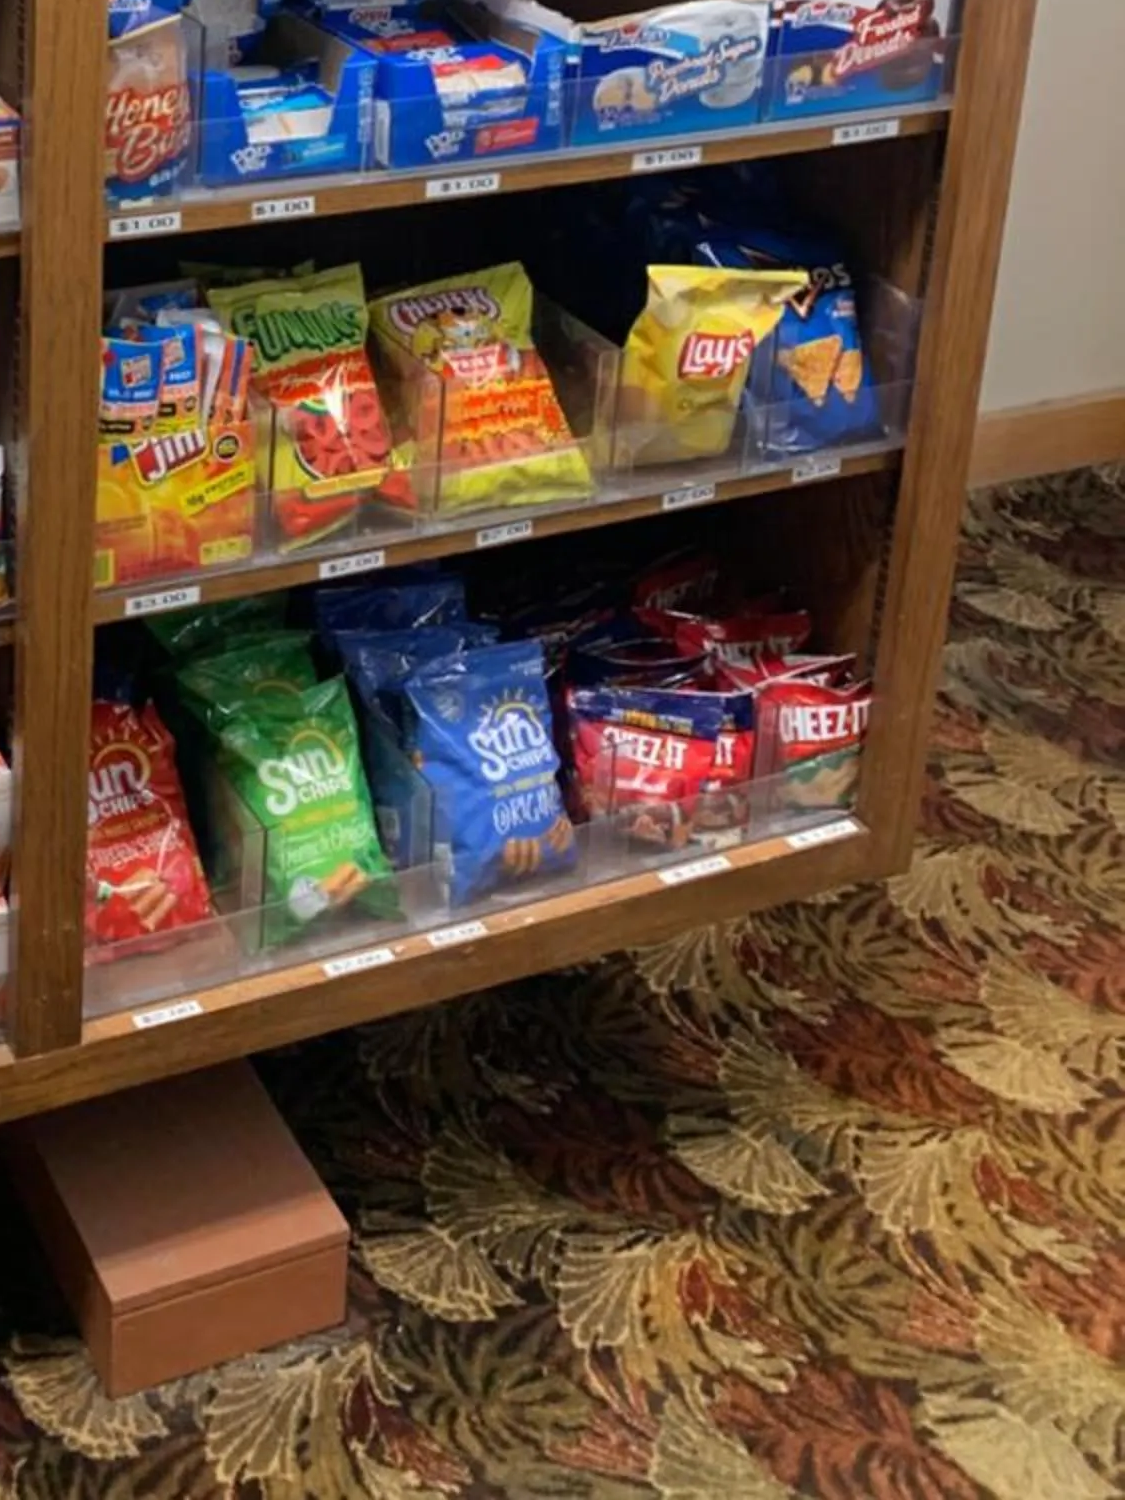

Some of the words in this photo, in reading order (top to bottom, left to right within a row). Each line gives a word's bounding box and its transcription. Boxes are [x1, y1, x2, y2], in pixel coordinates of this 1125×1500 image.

[115, 215, 176, 232] $1.00
[682, 329, 755, 376] Lay's
[468, 711, 546, 781] Sun
[505, 747, 554, 773] CHIPS
[258, 747, 346, 816] Sun
[296, 774, 353, 804] CHIPS
